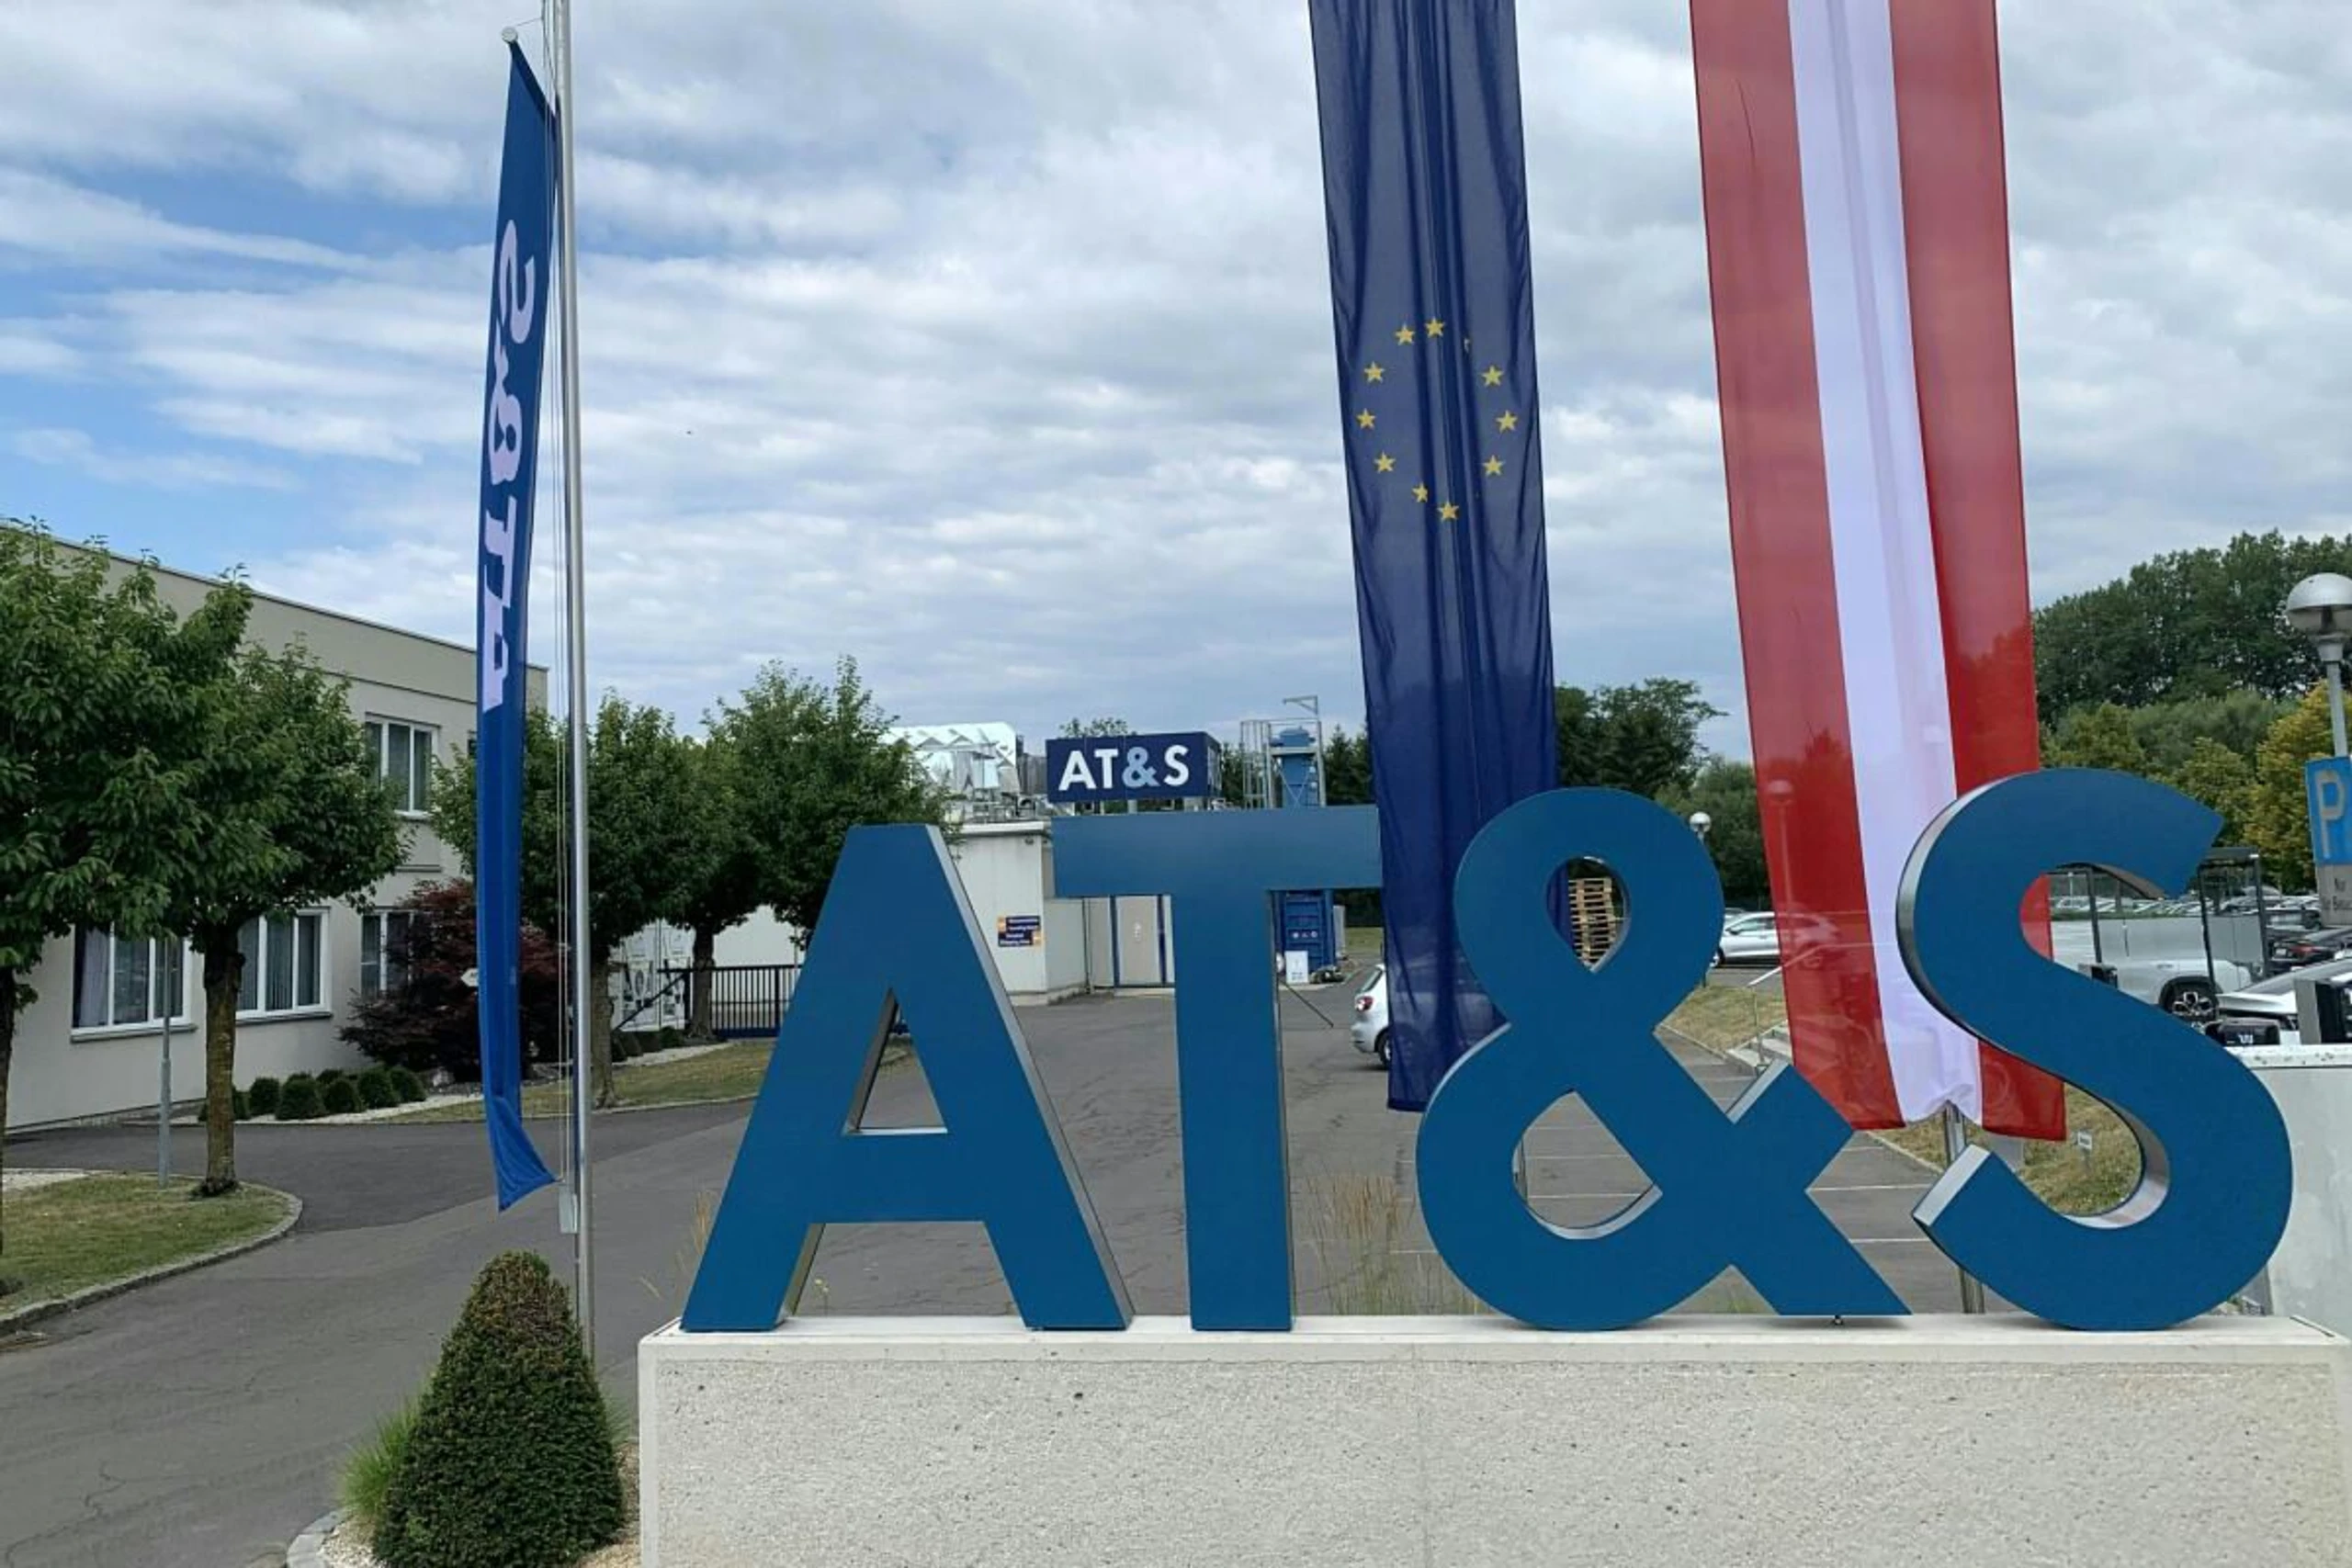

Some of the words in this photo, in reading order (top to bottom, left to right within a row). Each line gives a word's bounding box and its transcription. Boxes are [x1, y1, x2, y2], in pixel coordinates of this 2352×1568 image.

[1058, 744, 1190, 791] AT&S
[2314, 770, 2346, 860] P
[680, 768, 2293, 1332] AT&S
